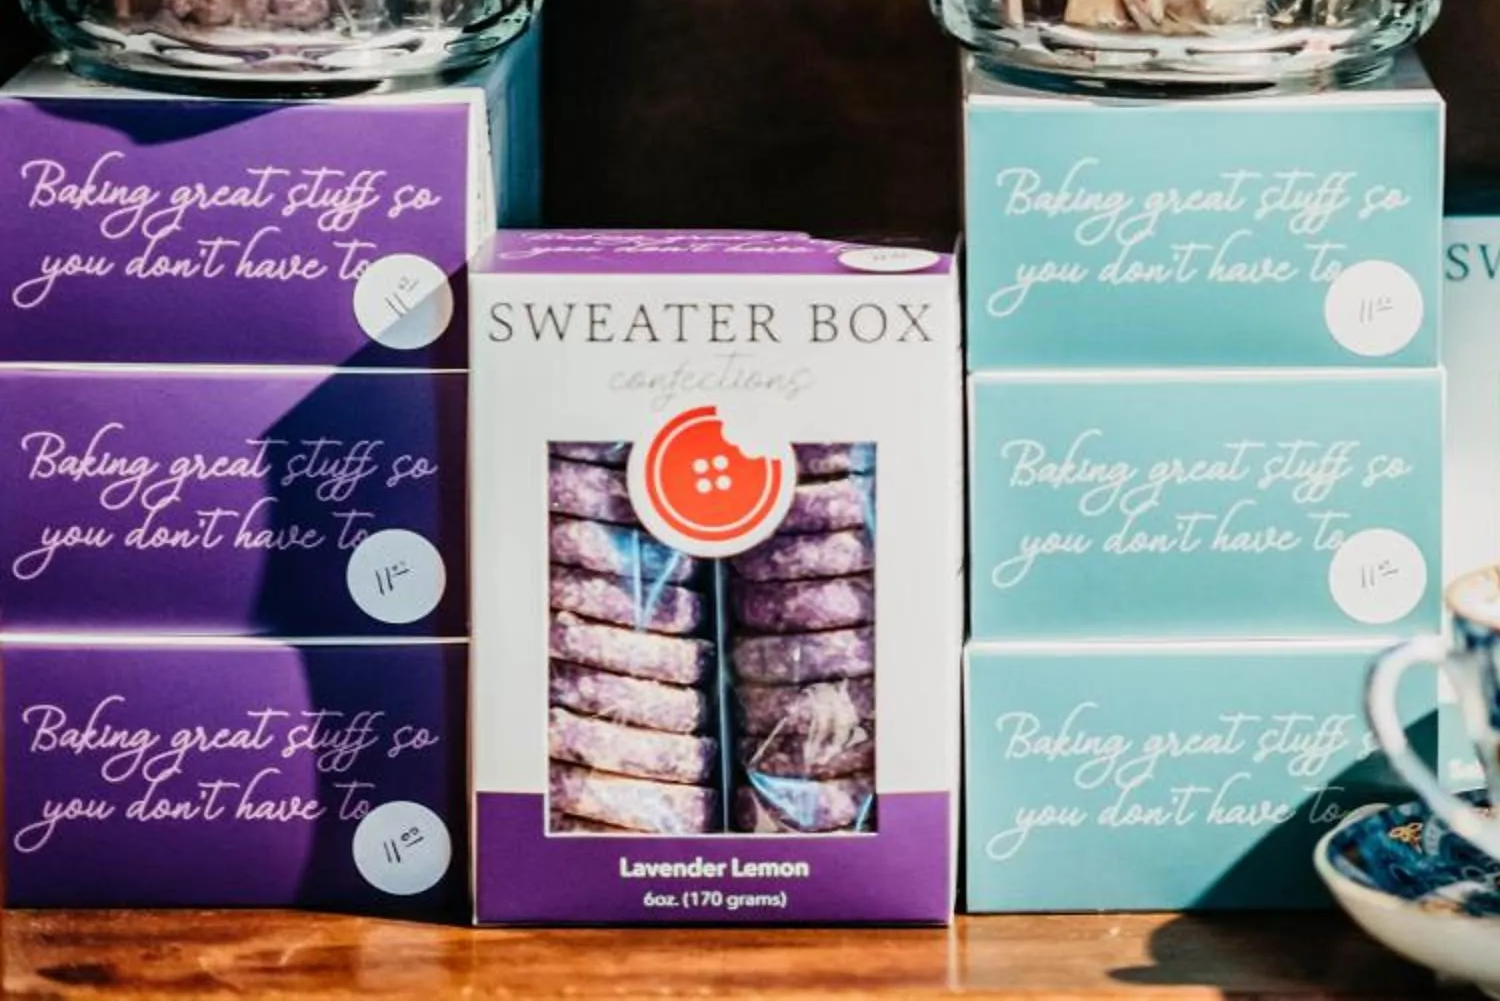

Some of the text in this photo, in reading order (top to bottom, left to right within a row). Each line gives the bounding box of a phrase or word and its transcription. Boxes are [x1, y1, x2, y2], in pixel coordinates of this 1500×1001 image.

[21, 151, 441, 240] Baking great stuff so
[997, 158, 1411, 246] Baking great stuff so
[13, 226, 375, 308] you don't have to
[987, 230, 1347, 316] you don't have to
[488, 301, 934, 344] SWEATER BOX
[608, 351, 818, 411] confections
[21, 423, 438, 510] Baking great stuff so
[1002, 429, 1414, 515] Baking great stuff so
[12, 497, 374, 580] you don't have to
[992, 500, 1351, 588] you don't have to
[22, 695, 439, 782] Baking great stuff so
[995, 702, 1356, 789] Baking great stuff
[14, 768, 375, 853] you don't have to
[986, 773, 1345, 859] you don't have to
[619, 857, 810, 878] Lavender Lemon
[643, 891, 788, 909] 6oz. (170 grams)
